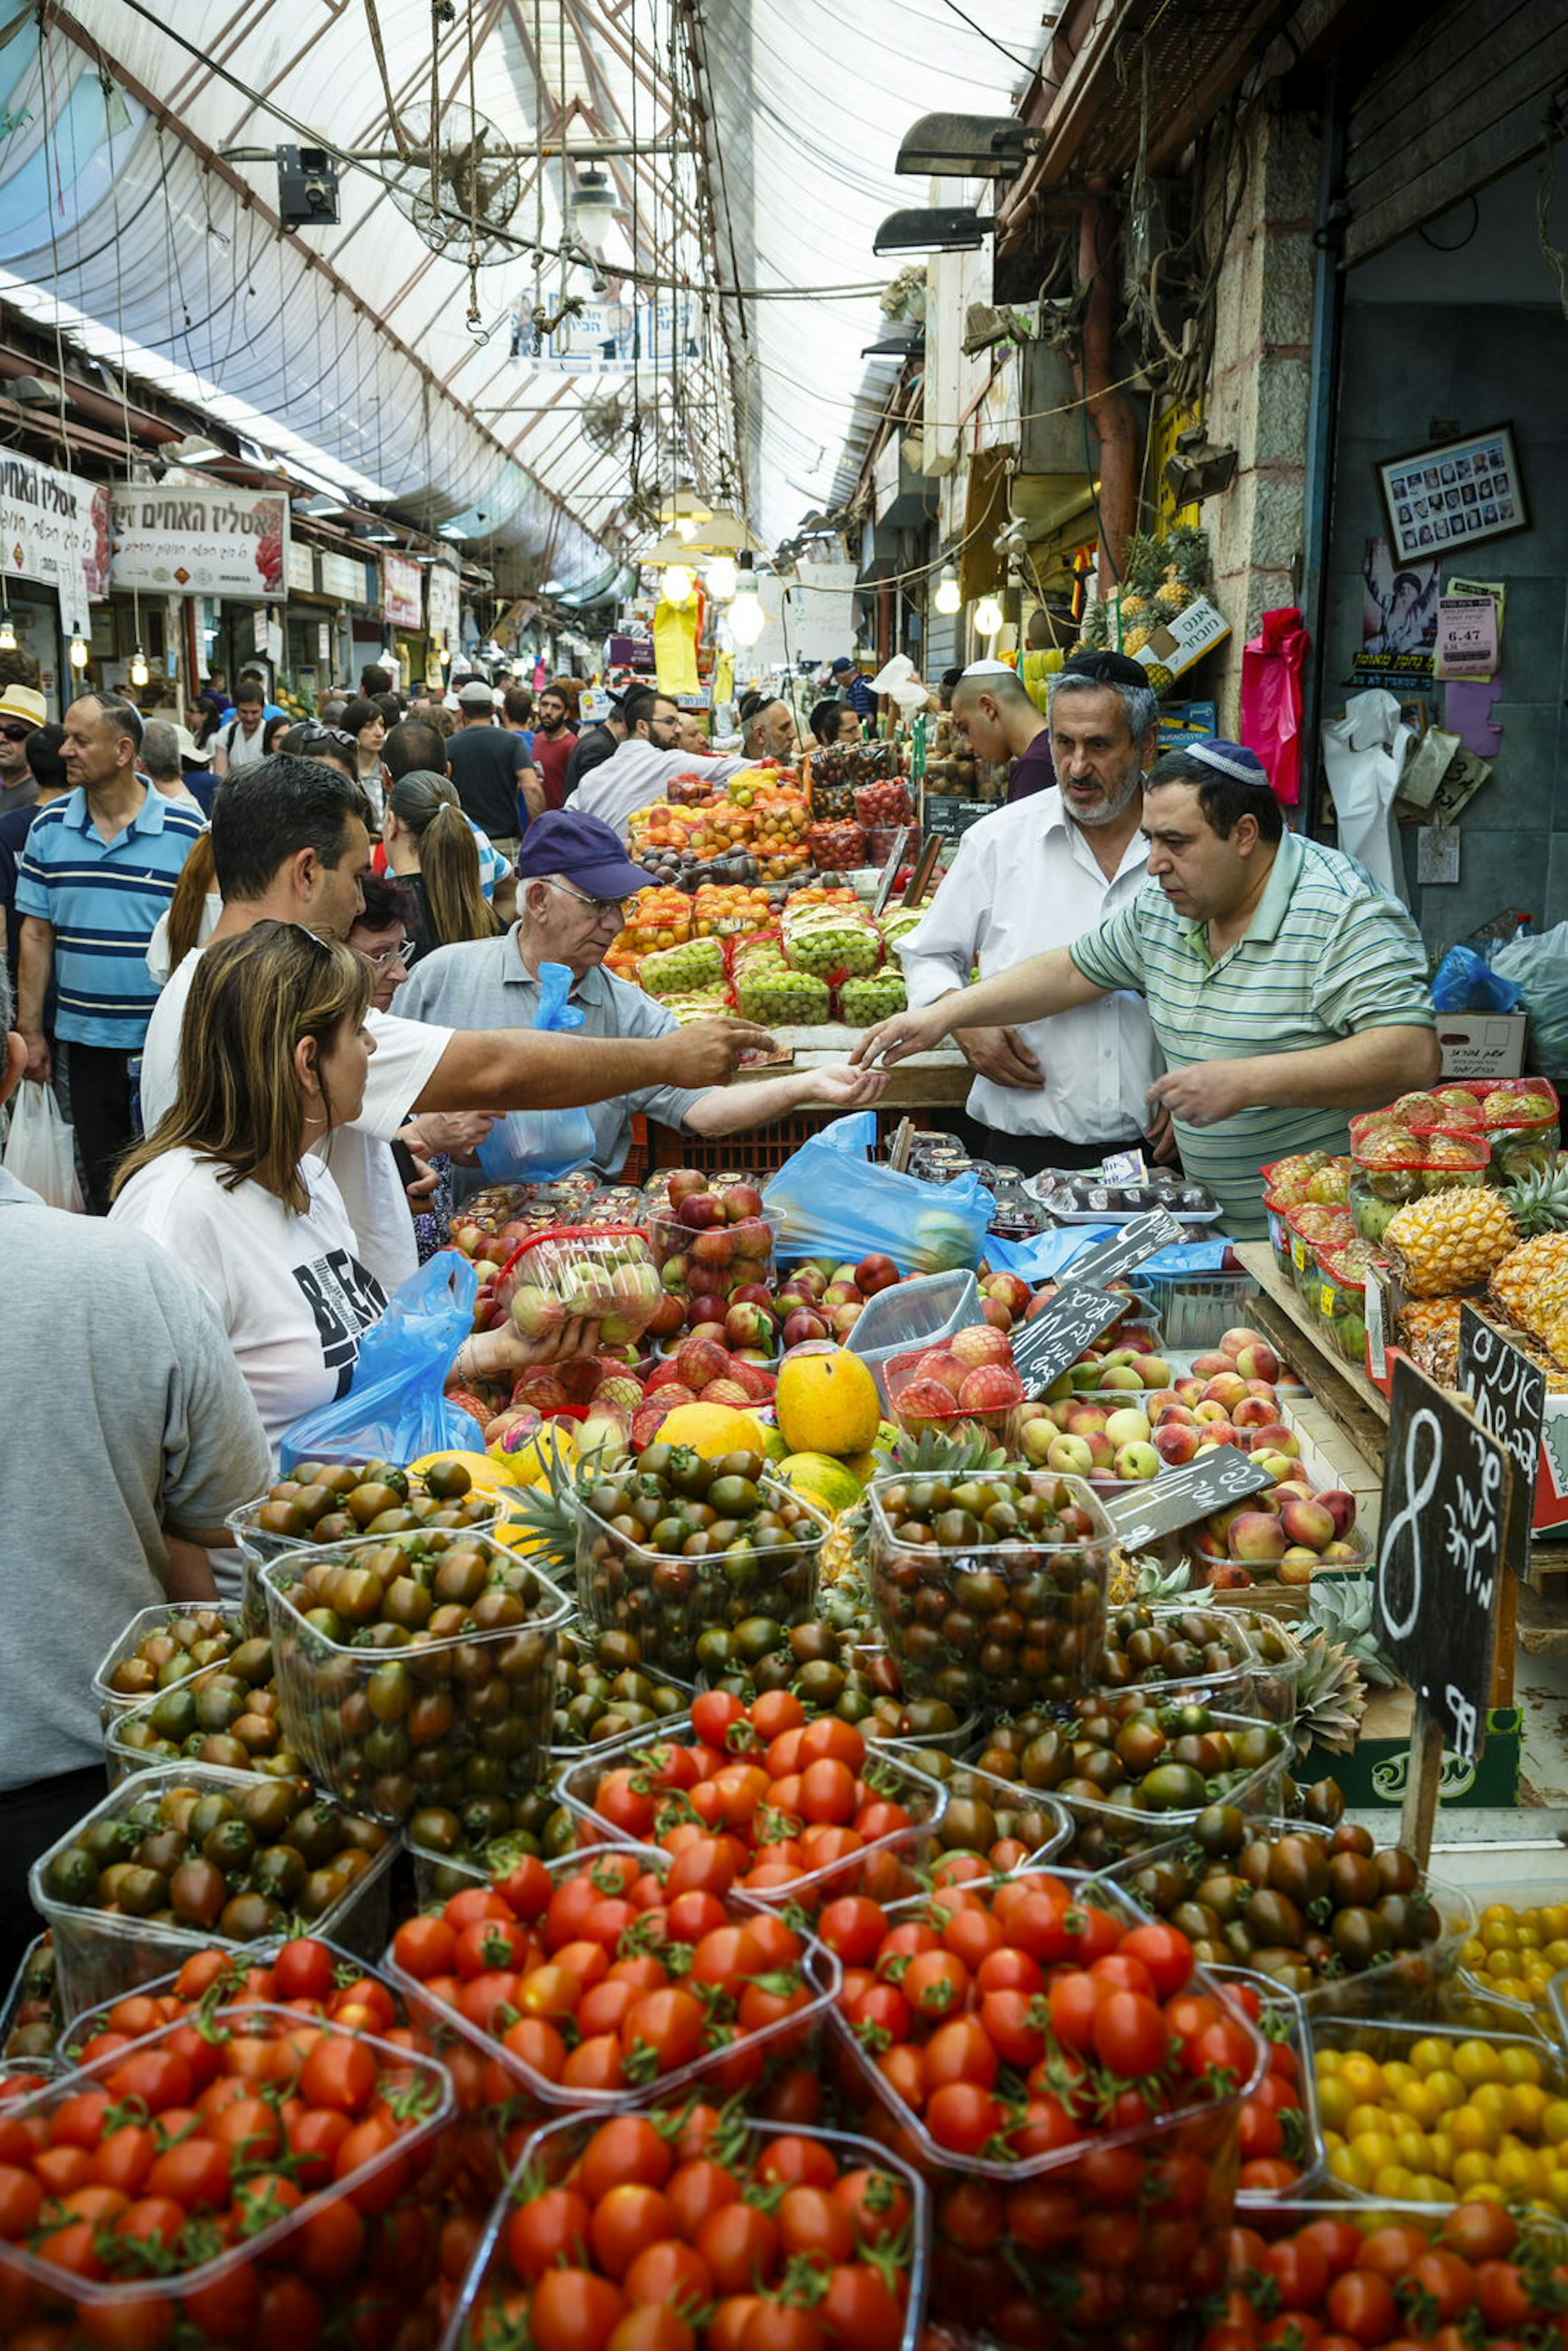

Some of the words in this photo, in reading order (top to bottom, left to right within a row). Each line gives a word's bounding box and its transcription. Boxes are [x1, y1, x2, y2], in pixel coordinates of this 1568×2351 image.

[42, 476, 77, 520] אטליז
[142, 501, 206, 531] האחים
[212, 501, 270, 535] אטליז
[1182, 606, 1210, 632] אננס
[1183, 619, 1219, 648] מובחר
[1449, 631, 1480, 641] 6.47
[1393, 655, 1423, 671] נחמן
[1055, 1287, 1120, 1321] אפרסק
[1473, 1327, 1540, 1420] אננס
